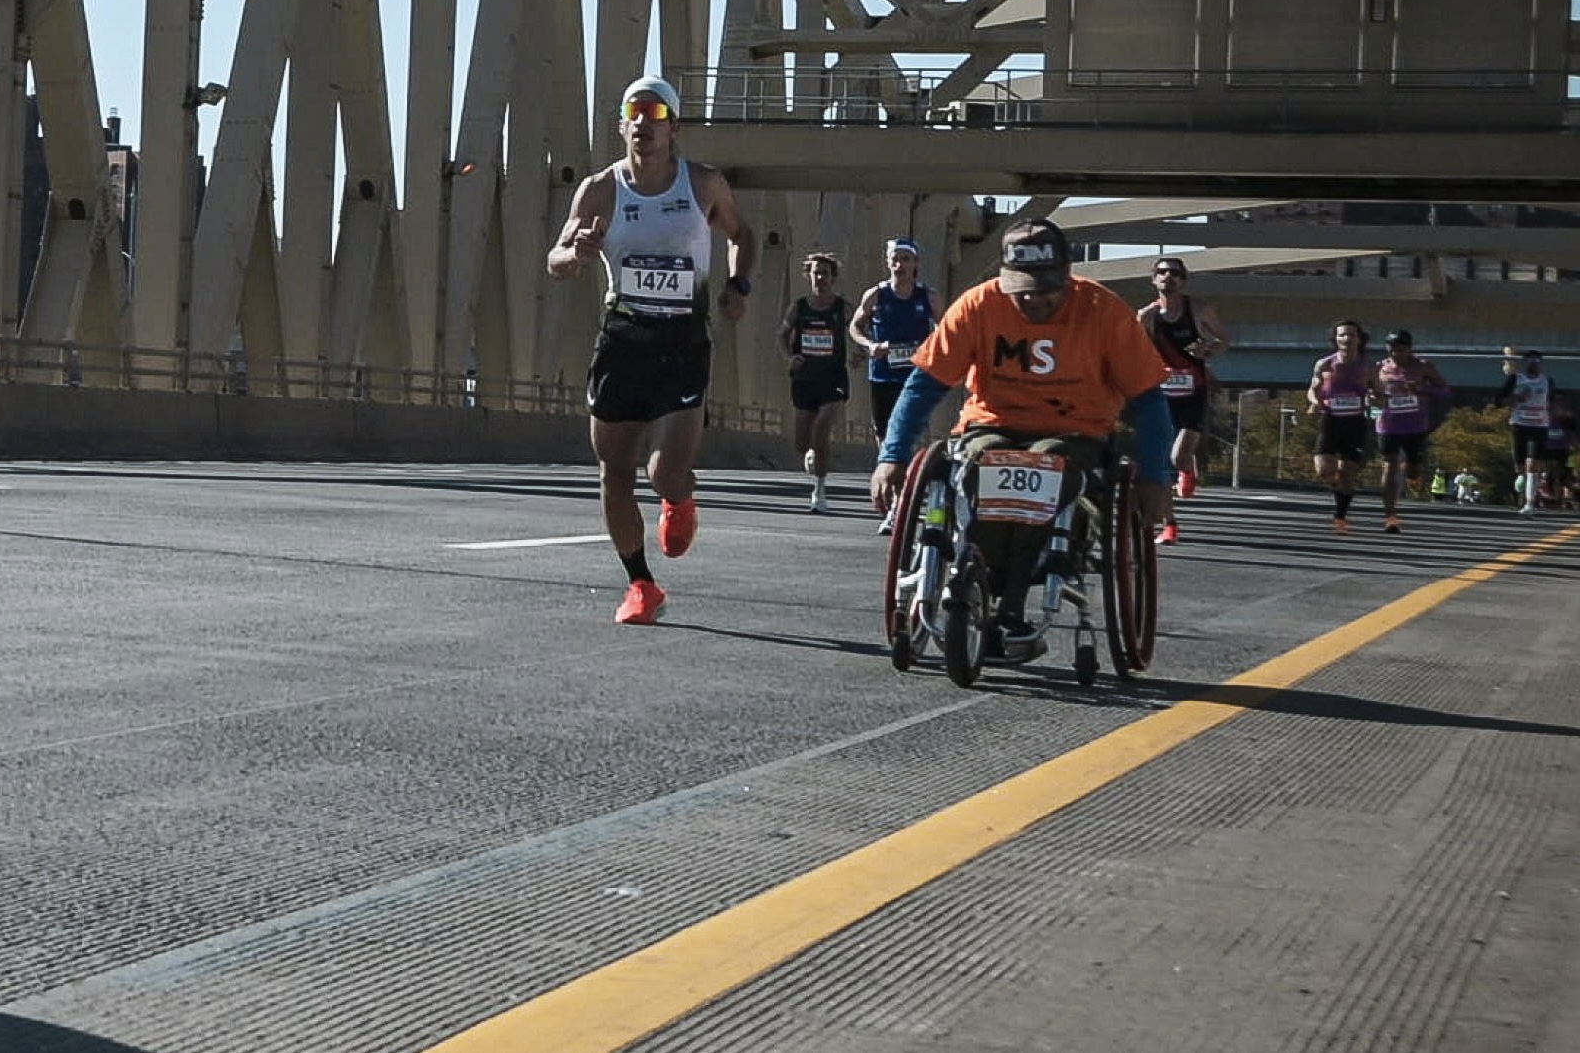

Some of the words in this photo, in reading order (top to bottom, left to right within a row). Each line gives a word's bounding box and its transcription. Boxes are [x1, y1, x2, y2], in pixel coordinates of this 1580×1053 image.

[633, 270, 679, 292] 1474
[994, 335, 1055, 374] MS
[997, 468, 1042, 493] 280
